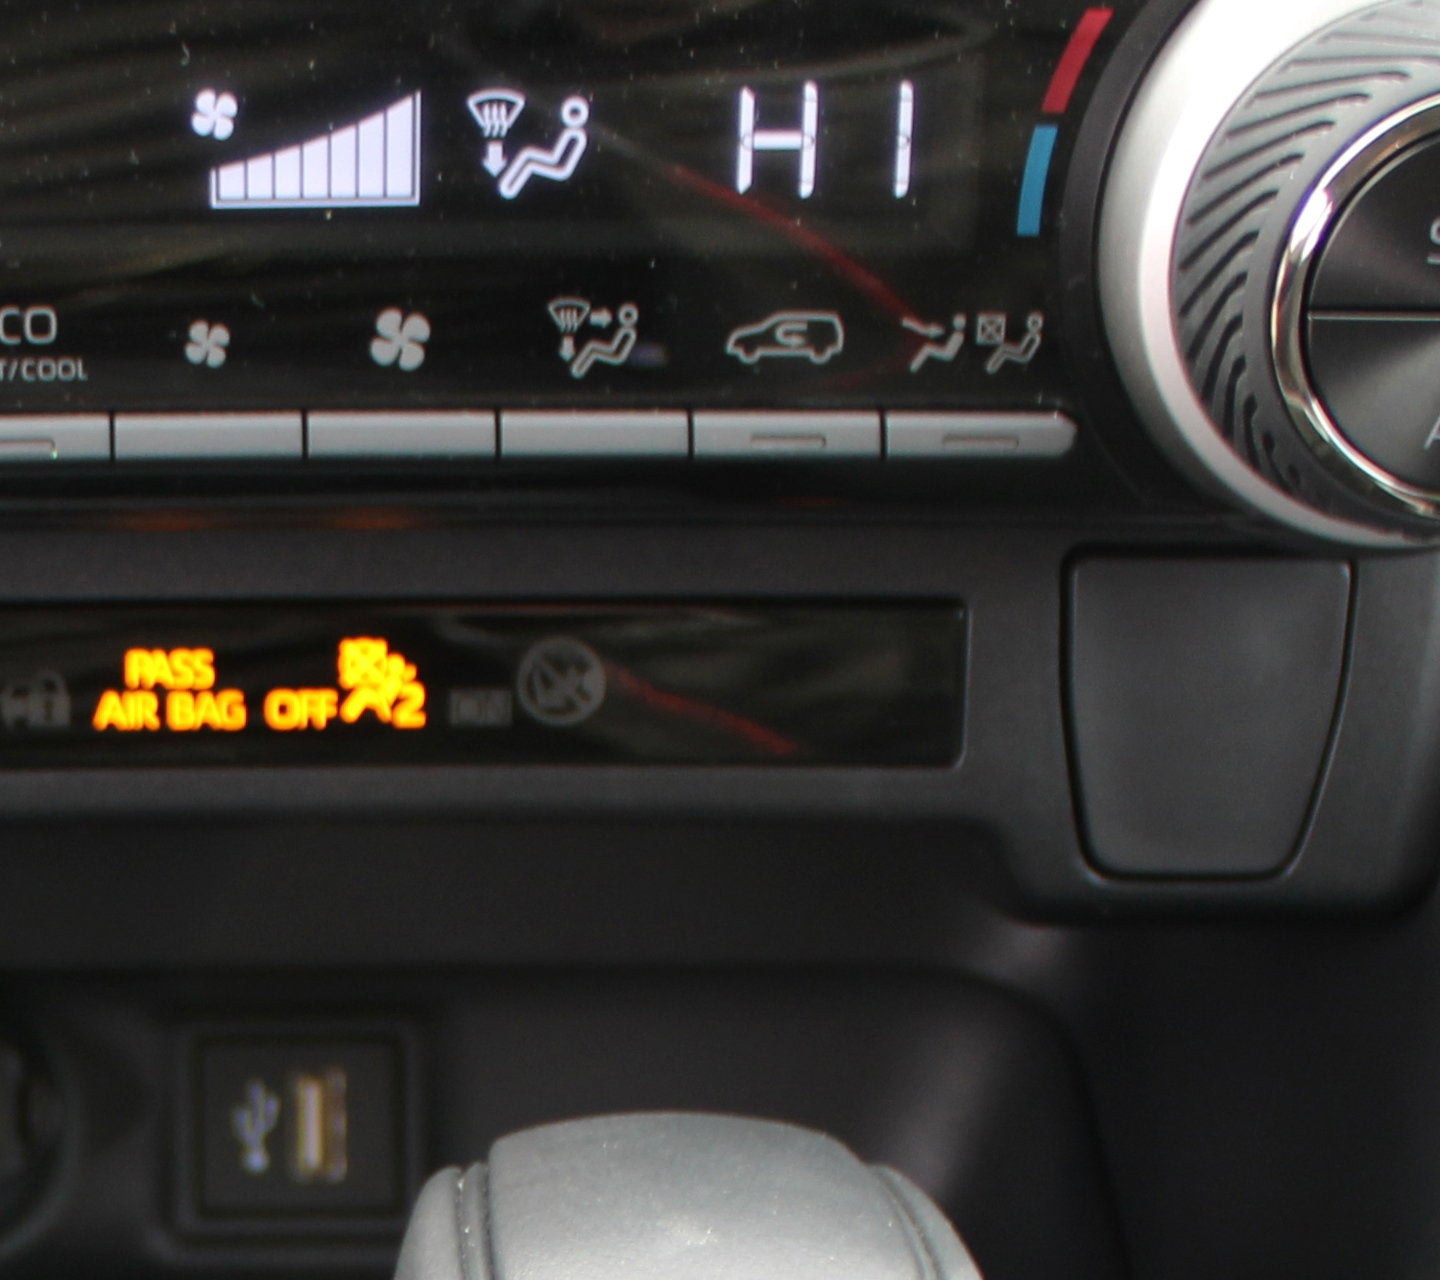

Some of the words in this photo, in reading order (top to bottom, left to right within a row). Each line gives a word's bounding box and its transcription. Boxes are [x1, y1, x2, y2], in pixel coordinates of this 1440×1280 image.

[124, 647, 215, 690] PASS
[92, 690, 160, 731] AIR
[166, 690, 247, 731] BAG
[263, 688, 338, 730] OFF
